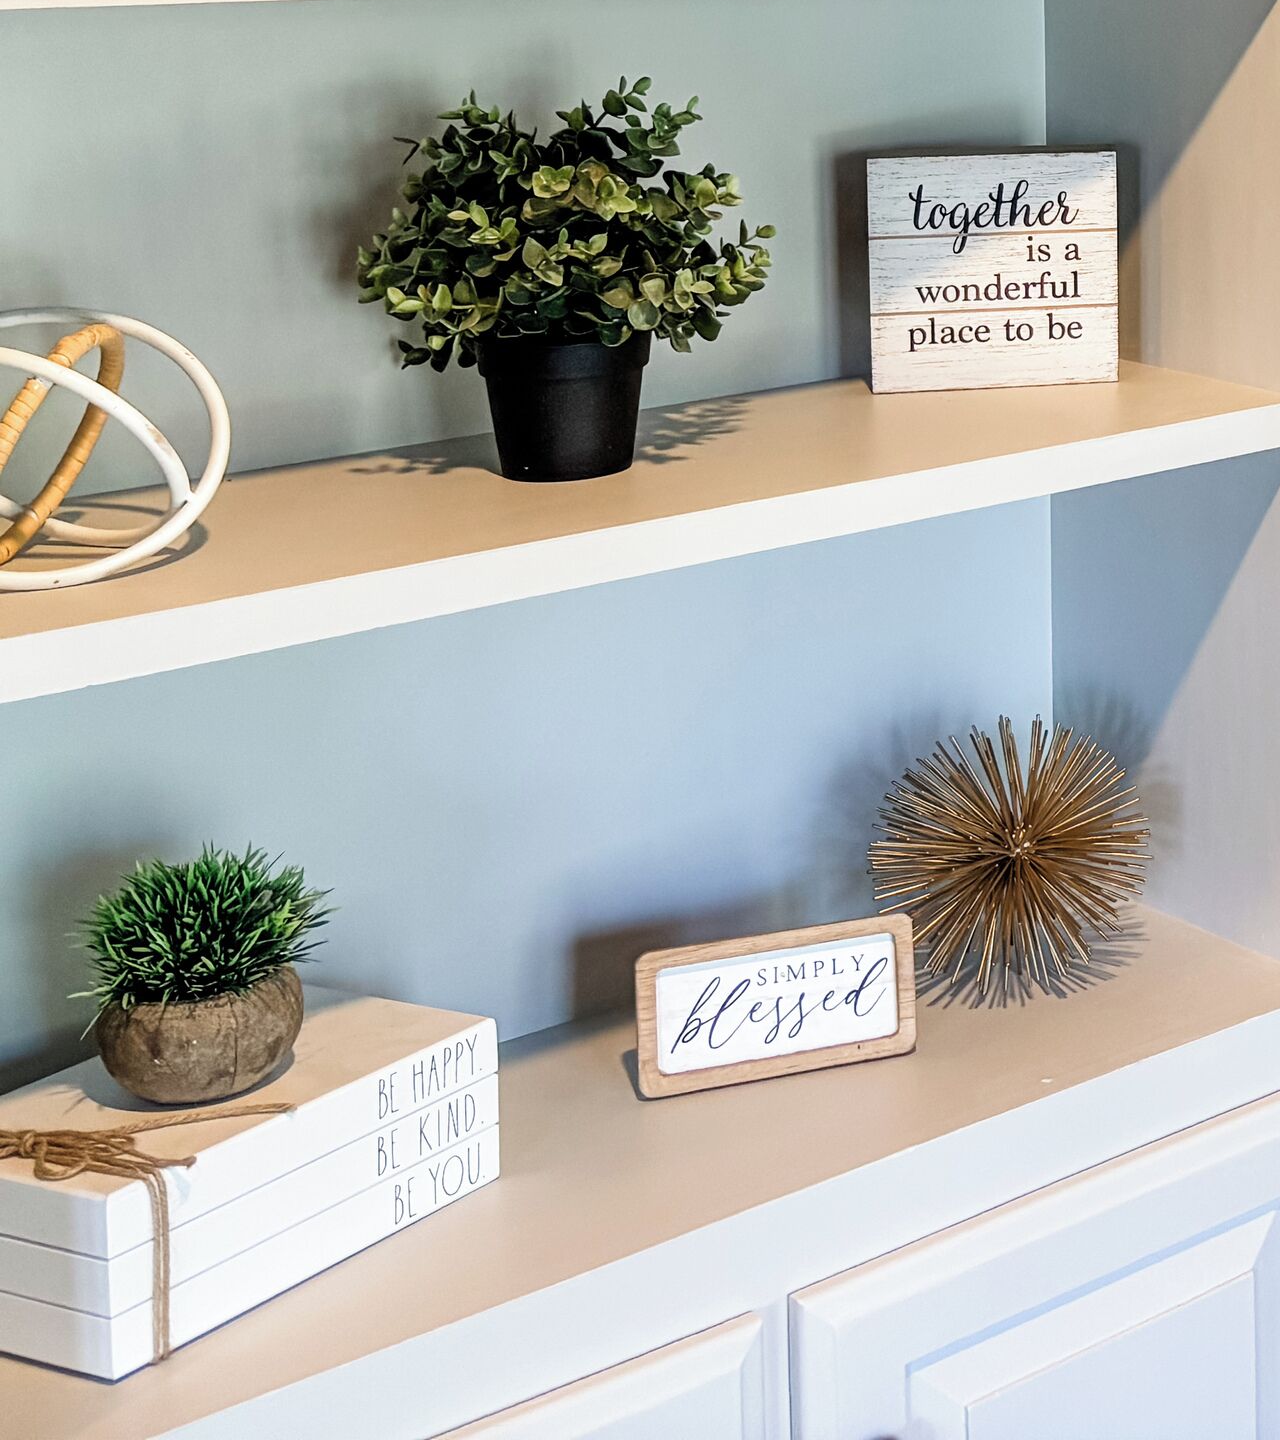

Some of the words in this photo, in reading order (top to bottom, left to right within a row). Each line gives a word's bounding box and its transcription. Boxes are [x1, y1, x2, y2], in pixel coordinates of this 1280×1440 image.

[909, 180, 1079, 254] together
[1027, 236, 1051, 262] is
[1065, 242, 1082, 260] a
[916, 272, 1081, 303] wonderful
[908, 318, 991, 352] place
[1004, 319, 1034, 341] to
[1047, 314, 1083, 340] be
[671, 958, 888, 1054] blessed
[756, 954, 864, 986] SIMPLY
[379, 1072, 399, 1119] BE
[413, 1034, 482, 1103] HAPPY.
[378, 1128, 400, 1176] BE
[419, 1094, 484, 1156] KIND.
[395, 1177, 417, 1225] BE
[429, 1143, 485, 1204] YOU.
